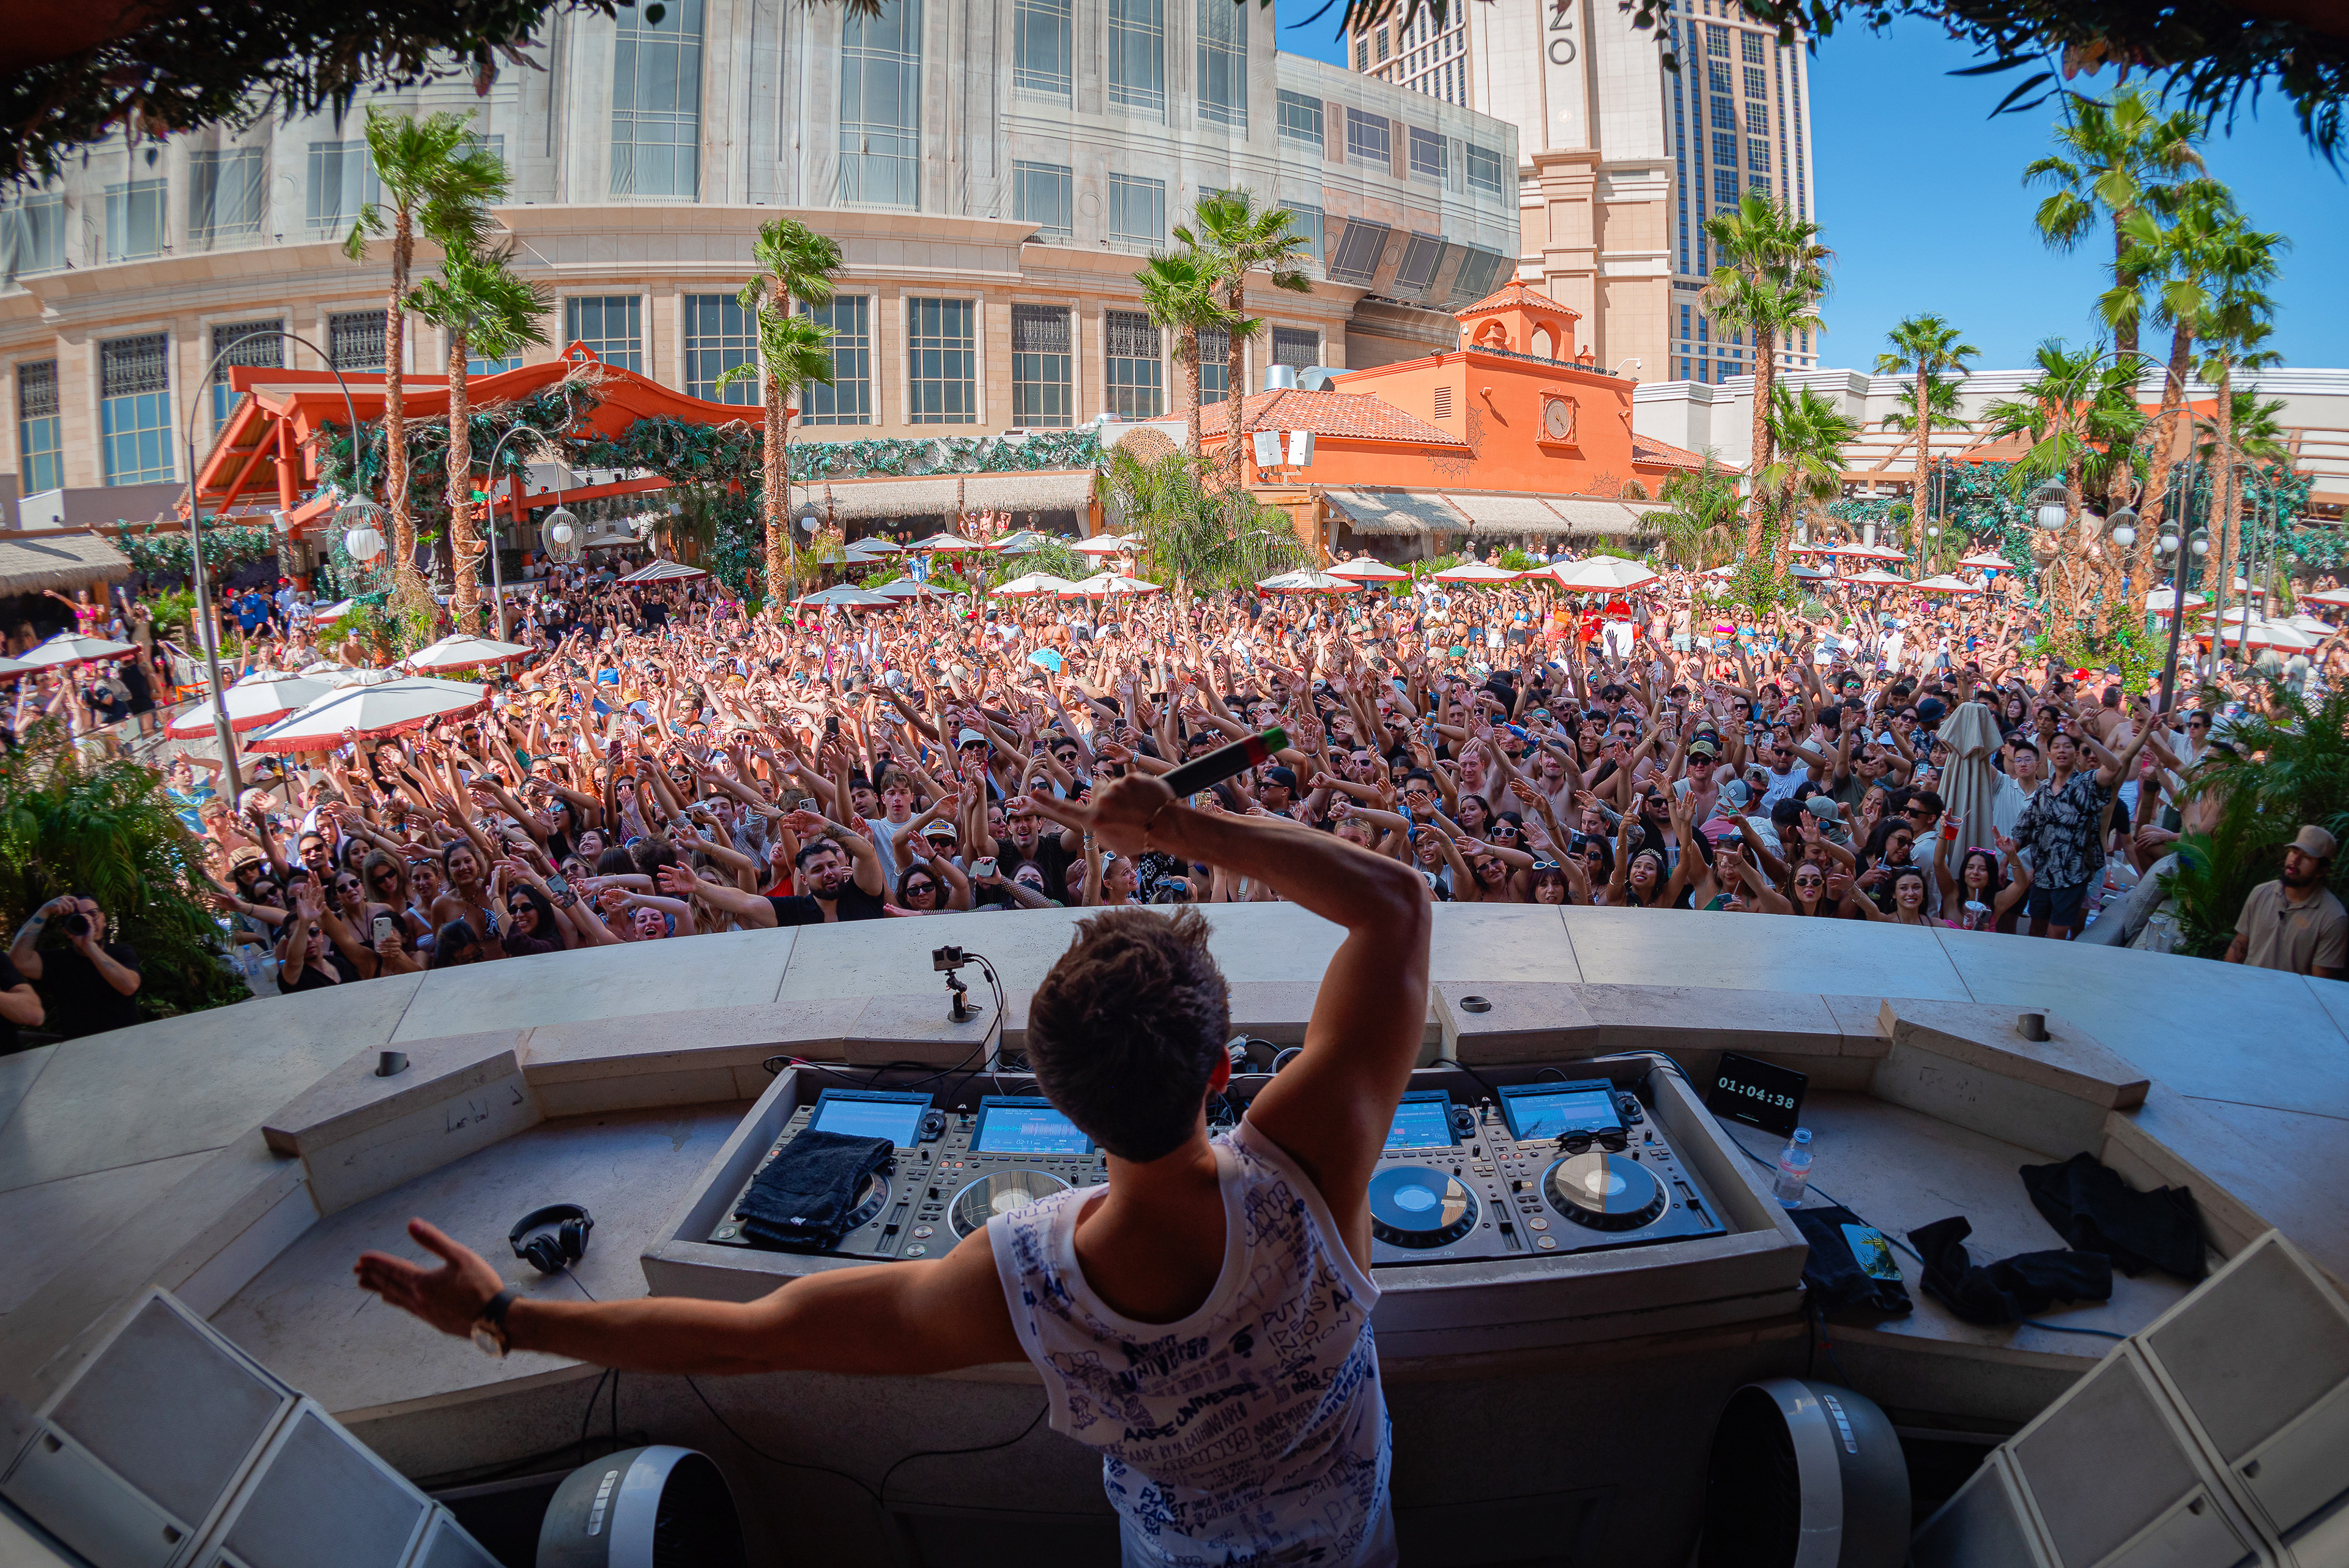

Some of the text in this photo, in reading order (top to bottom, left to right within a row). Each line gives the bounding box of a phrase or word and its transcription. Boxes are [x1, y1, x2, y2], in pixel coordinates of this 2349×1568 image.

[1718, 1077, 1794, 1109] 01:04:38
[1261, 1264, 1340, 1331] PUTTING
[1267, 1296, 1327, 1347] IDEAS
[1275, 1320, 1319, 1358] INTO
[1280, 1310, 1351, 1369] ACTION
[1253, 1395, 1319, 1443] SOMEWHERE
[1204, 1507, 1218, 1521] GO
